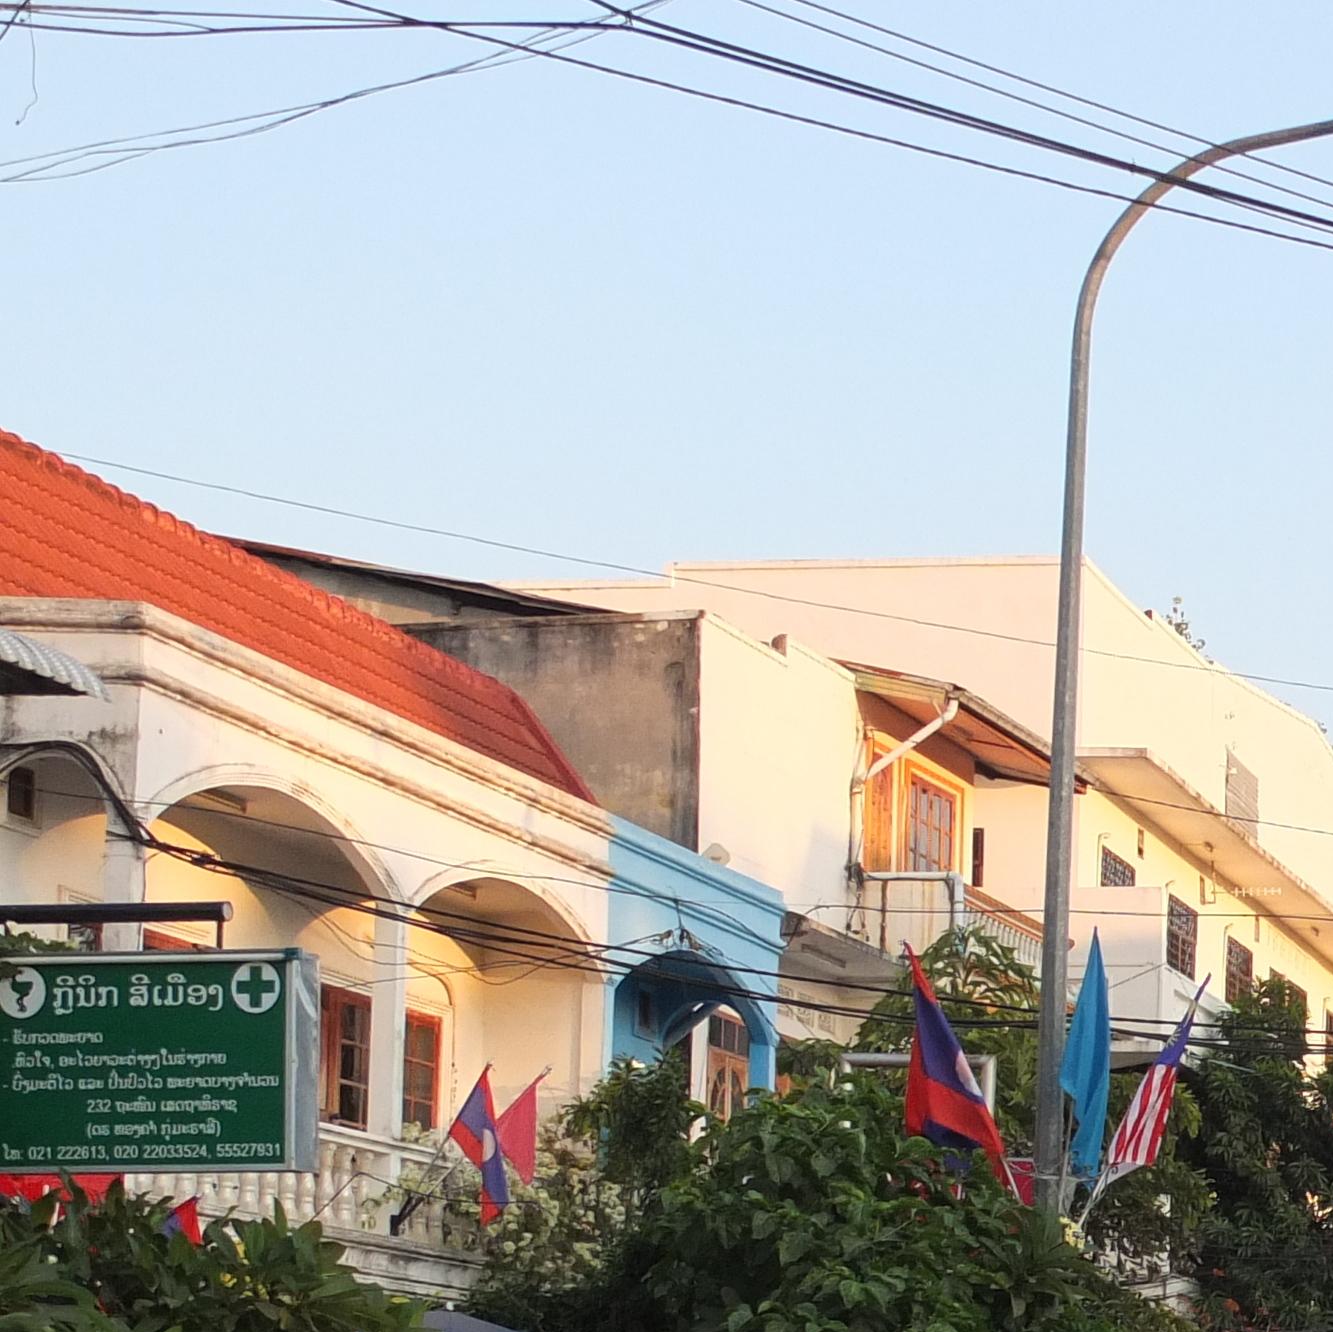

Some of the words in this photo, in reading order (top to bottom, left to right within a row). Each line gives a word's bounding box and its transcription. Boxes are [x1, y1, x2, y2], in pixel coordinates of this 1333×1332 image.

[87, 1099, 111, 1113] 232
[28, 1146, 51, 1160] 021
[113, 1145, 139, 1160] 020
